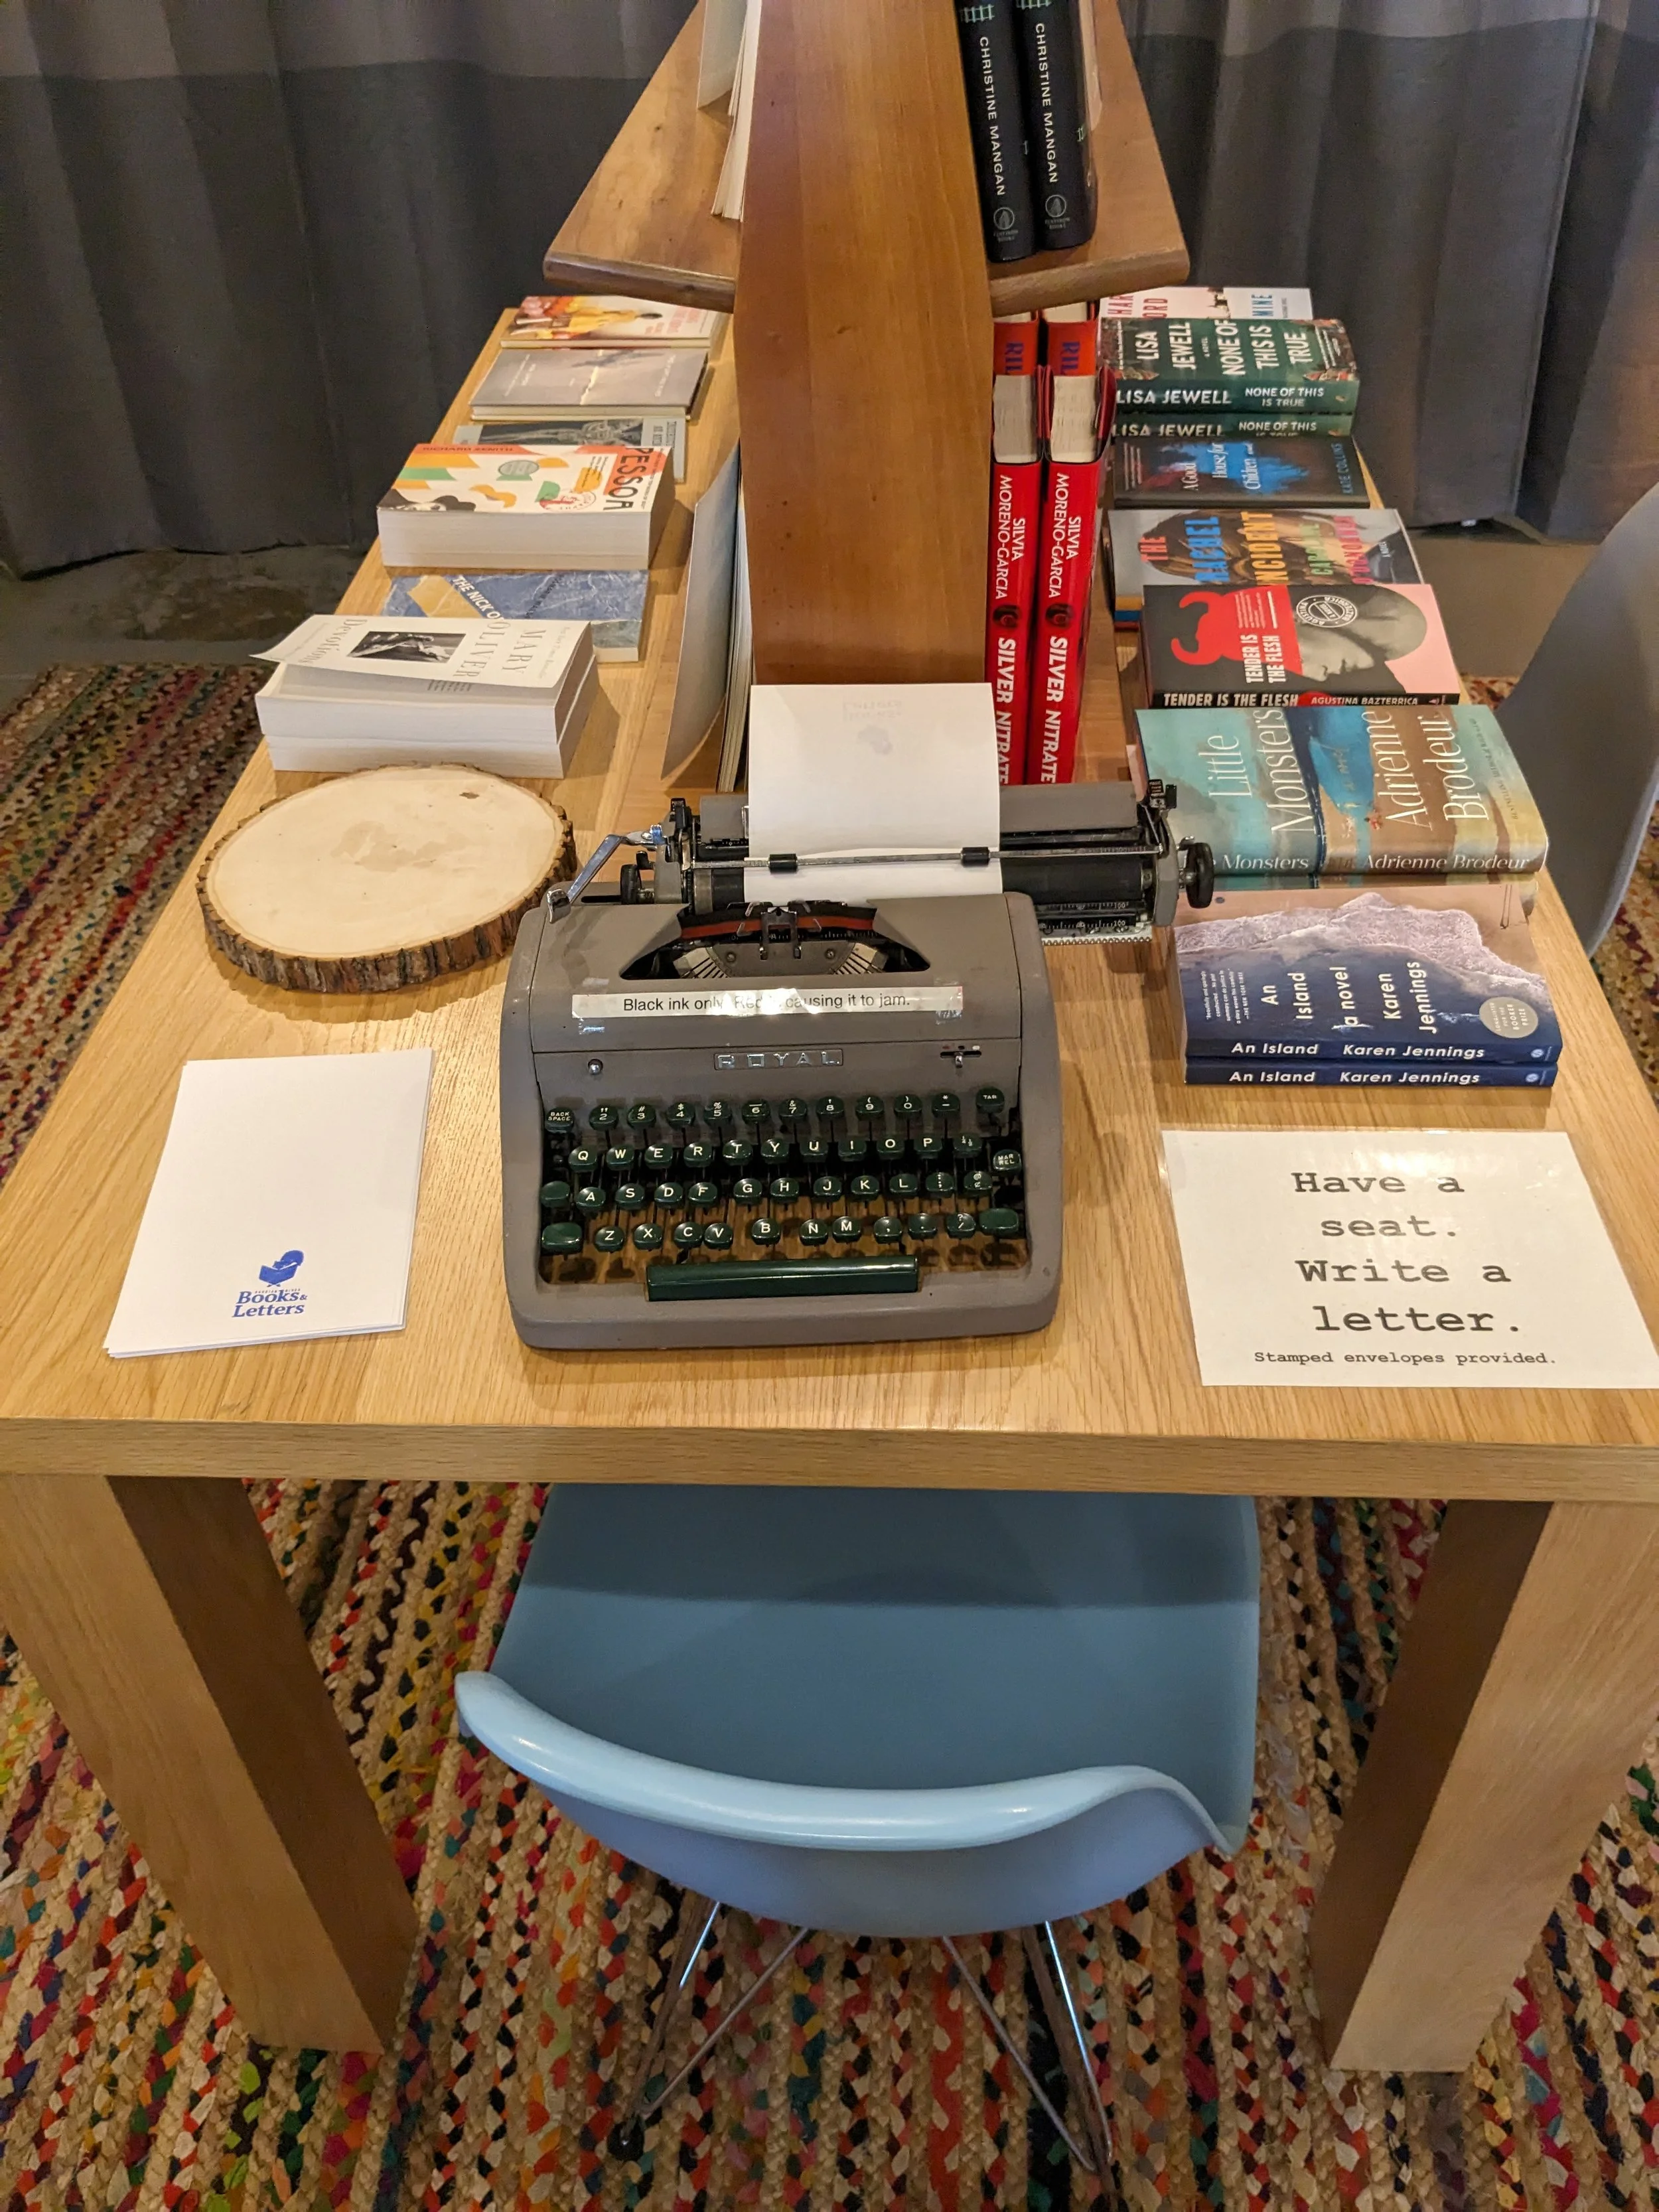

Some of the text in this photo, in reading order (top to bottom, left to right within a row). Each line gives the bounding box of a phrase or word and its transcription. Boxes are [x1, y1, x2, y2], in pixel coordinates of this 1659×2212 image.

[1036, 23, 1058, 183] CHRISTINE MANGAN
[979, 37, 1005, 195] CHRISTINE MANGAN
[1135, 331, 1159, 360] LISA
[1169, 323, 1196, 370] JEWELL
[1214, 319, 1246, 376] NONE OF
[1249, 325, 1279, 370] THIS IS
[1283, 332, 1313, 364] TRUE
[1116, 390, 1232, 404] LISA JEWELL
[1245, 388, 1325, 398] NONE OF THIS
[1112, 423, 1226, 437] LISA JEWELL
[1239, 421, 1317, 431] NONE OF THIS
[1207, 443, 1228, 479] House for
[603, 447, 654, 510] PESSOA
[1181, 463, 1198, 483] Good
[1244, 458, 1261, 490] Children
[995, 475, 1013, 599] MORENO-GARCIA
[1011, 518, 1026, 561] SILVIA
[1048, 473, 1070, 598] MORENO-GARCIA
[1066, 516, 1082, 560] SILVIA
[1140, 536, 1169, 561] THE
[1185, 516, 1230, 582] RACHEL
[453, 575, 474, 592] THE
[467, 590, 494, 612] NICK
[1240, 634, 1258, 644] IS
[453, 622, 510, 677] OLIVER
[502, 630, 546, 674] MARY
[1242, 646, 1264, 684] TENDER
[1262, 635, 1287, 684] THE FLESH
[996, 637, 1016, 703] SILVER
[1163, 693, 1419, 707] TENDER IS THE FLESH AGUSTINA BAZTERRICA
[1041, 636, 1068, 783] SILVER NITRATE
[1198, 735, 1253, 798] Little
[1252, 709, 1317, 834] Monsters
[1361, 710, 1433, 831] Adrienne
[1417, 715, 1489, 821] Brodeur
[1222, 854, 1309, 869] Monsters
[1364, 854, 1447, 869] Adrienne
[1453, 854, 1530, 869] Brodeur
[623, 998, 664, 1011] Black
[668, 997, 689, 1010] ink
[785, 994, 843, 1011] causing
[847, 995, 857, 1007] it
[860, 994, 875, 1006] to
[879, 994, 910, 1009] jam.
[1261, 984, 1279, 1005] An
[1287, 972, 1314, 1019] Island
[1329, 966, 1358, 1026] a novel
[1378, 973, 1402, 1019] Karen
[1407, 962, 1437, 1034] Jennings
[1507, 1003, 1520, 1031] BOOKER
[1518, 1008, 1528, 1026] PRIZE
[717, 1051, 839, 1069] ROYAL
[1231, 1043, 1485, 1059] An Island Karen Jennings
[1229, 1071, 1480, 1085] An Island Karen Jennings
[694, 1147, 703, 1156] R
[733, 1144, 743, 1153] T
[770, 1143, 781, 1153] Y
[809, 1141, 820, 1151] U
[885, 1139, 895, 1148] O
[924, 1138, 932, 1147] P
[578, 1151, 589, 1161] Q
[614, 1149, 626, 1159] W
[654, 1148, 664, 1157] E
[664, 1187, 674, 1197] D
[698, 1187, 708, 1197] F
[743, 1184, 753, 1193] G
[780, 1182, 790, 1192] H
[822, 1181, 831, 1191] J
[860, 1180, 870, 1190] K
[899, 1179, 908, 1188] L
[1291, 1172, 1465, 1194] Have a
[585, 1192, 595, 1201] A
[626, 1188, 635, 1198] S
[643, 1228, 653, 1238] X
[684, 1227, 693, 1237] C
[714, 1228, 725, 1238] V
[761, 1223, 771, 1233] B
[808, 1224, 818, 1234] N
[841, 1221, 852, 1231] M
[1320, 1215, 1457, 1238] seat.
[605, 1231, 615, 1240] Z
[1295, 1260, 1512, 1283] Write a
[236, 1290, 299, 1304] Books
[232, 1304, 305, 1318] Letters
[1312, 1305, 1520, 1333] letter.
[1254, 1352, 1557, 1366] Stamped envelopes provided.
